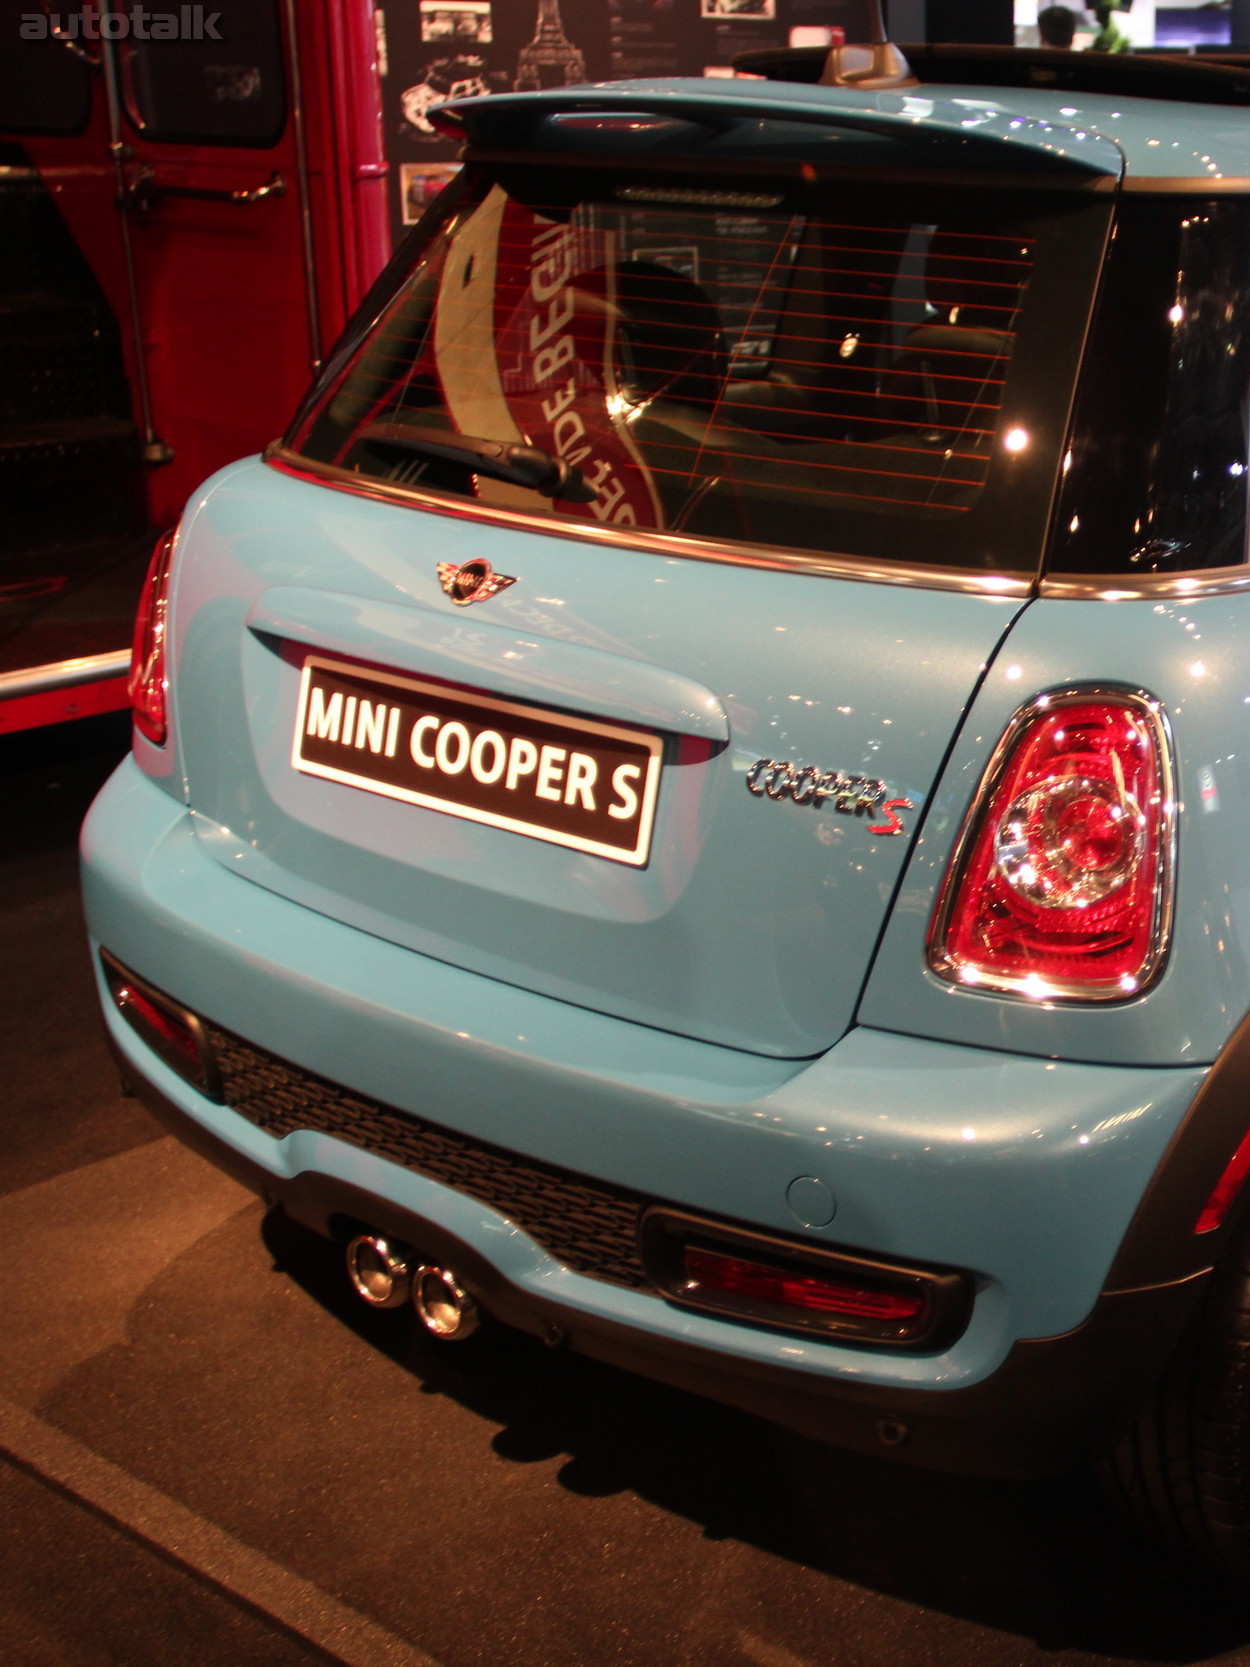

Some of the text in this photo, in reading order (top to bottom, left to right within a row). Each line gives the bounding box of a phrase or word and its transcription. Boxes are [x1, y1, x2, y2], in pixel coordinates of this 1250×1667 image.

[306, 686, 641, 820] MINI COOPER S
[746, 757, 914, 835] COOPER S
